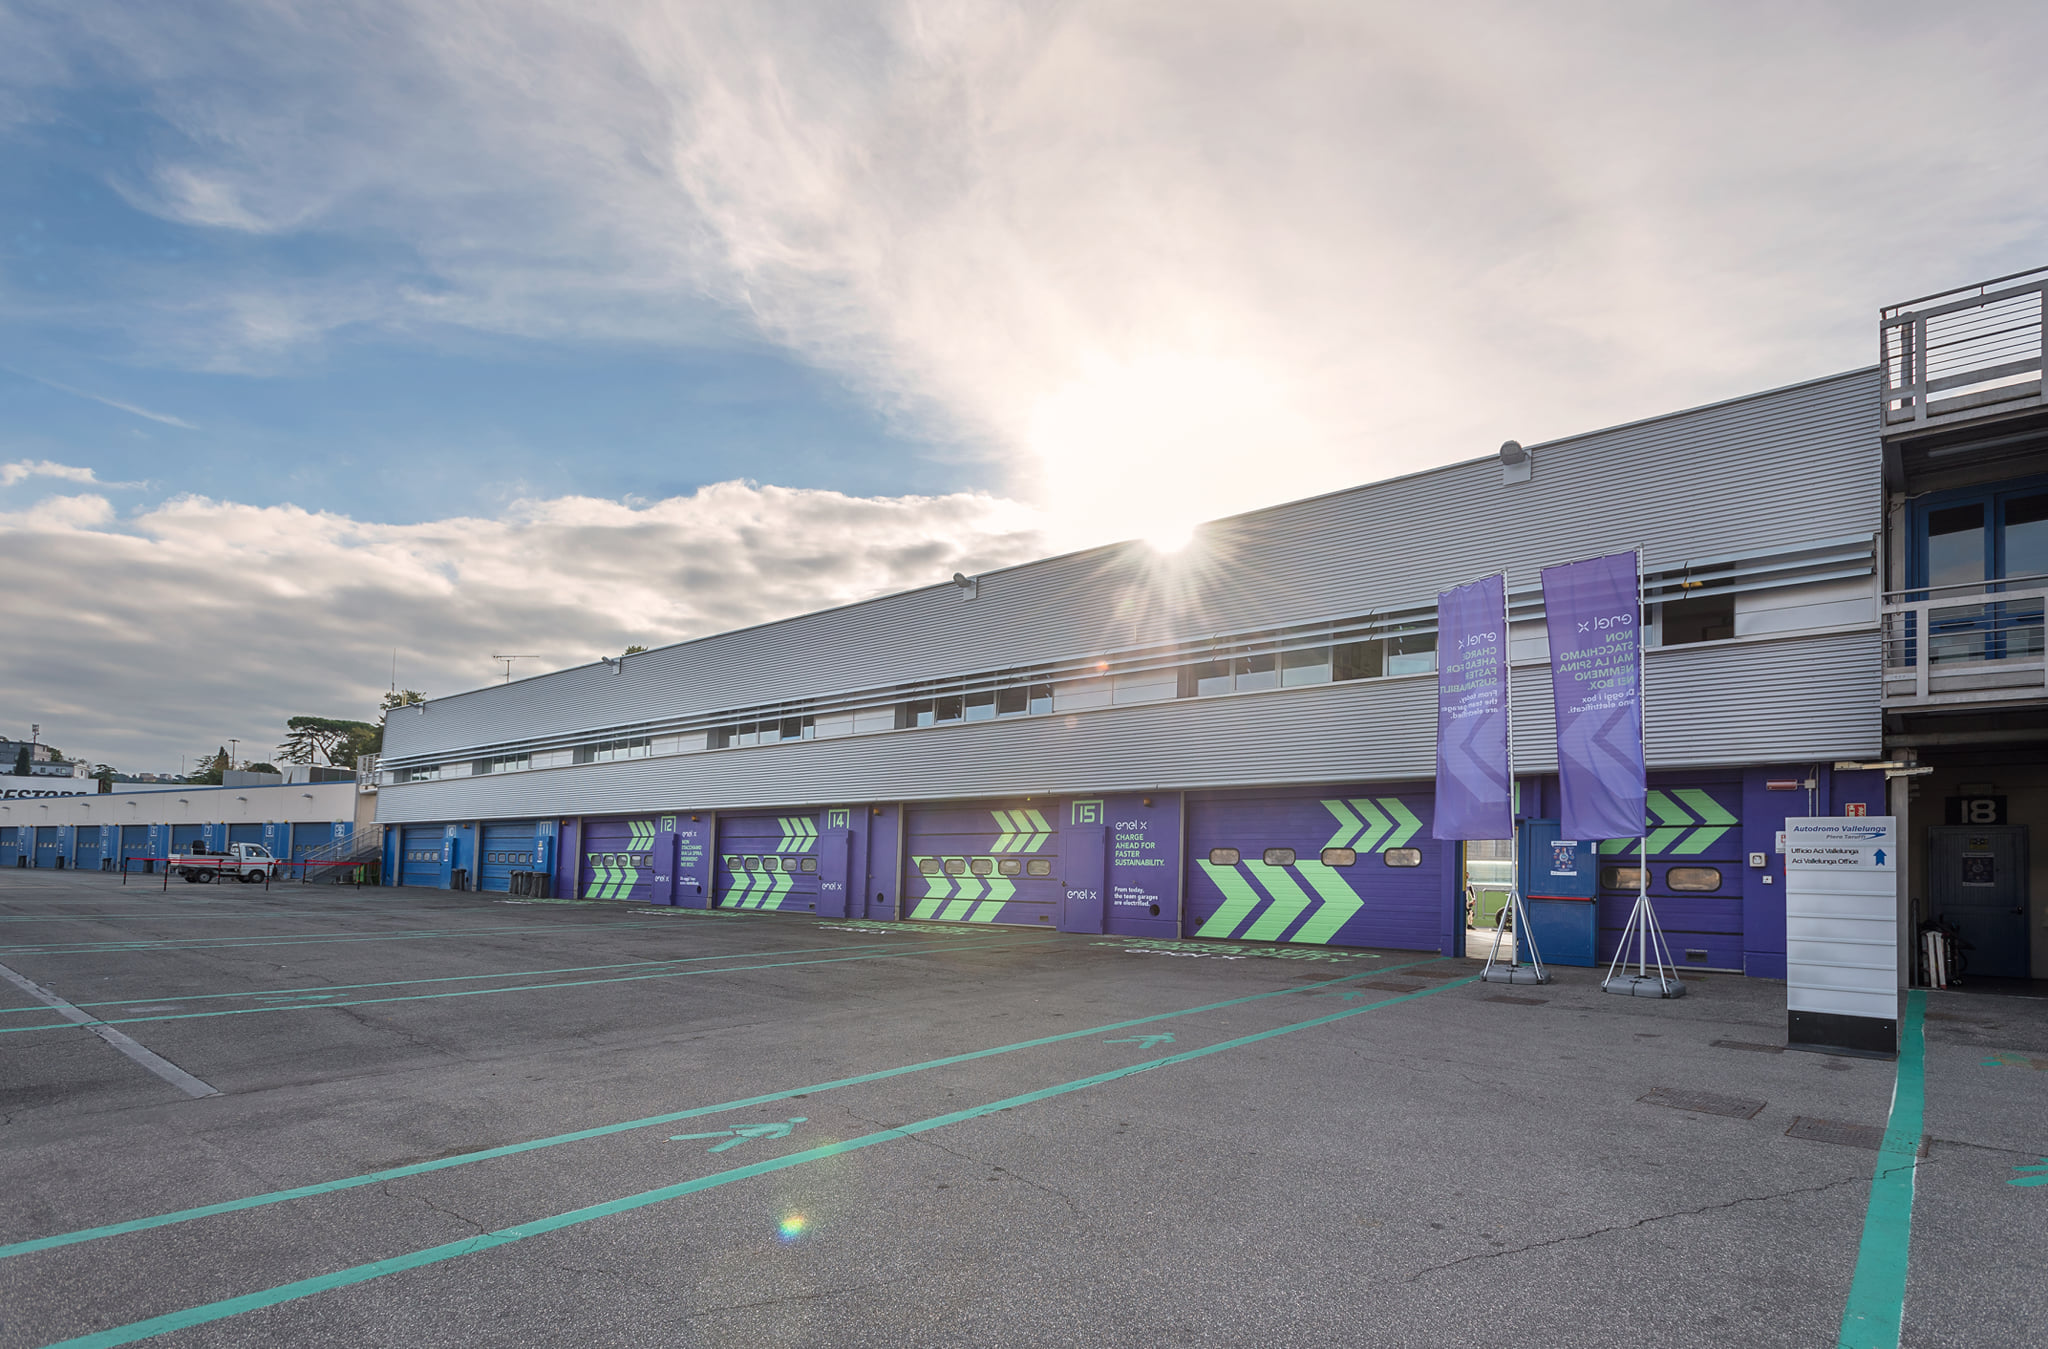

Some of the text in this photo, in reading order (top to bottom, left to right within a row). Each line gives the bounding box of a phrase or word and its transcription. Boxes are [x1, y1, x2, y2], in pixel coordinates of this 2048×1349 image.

[1080, 805, 1096, 823] 15
[1961, 799, 1996, 824] 18
[664, 819, 672, 831] 12
[833, 813, 844, 828] 14
[1115, 820, 1148, 830] enel x
[1841, 825, 1887, 833] Vallelunga
[1115, 833, 1144, 841] CHARGE
[1825, 847, 1859, 855] Vallelunga
[1067, 889, 1097, 900] enel x
